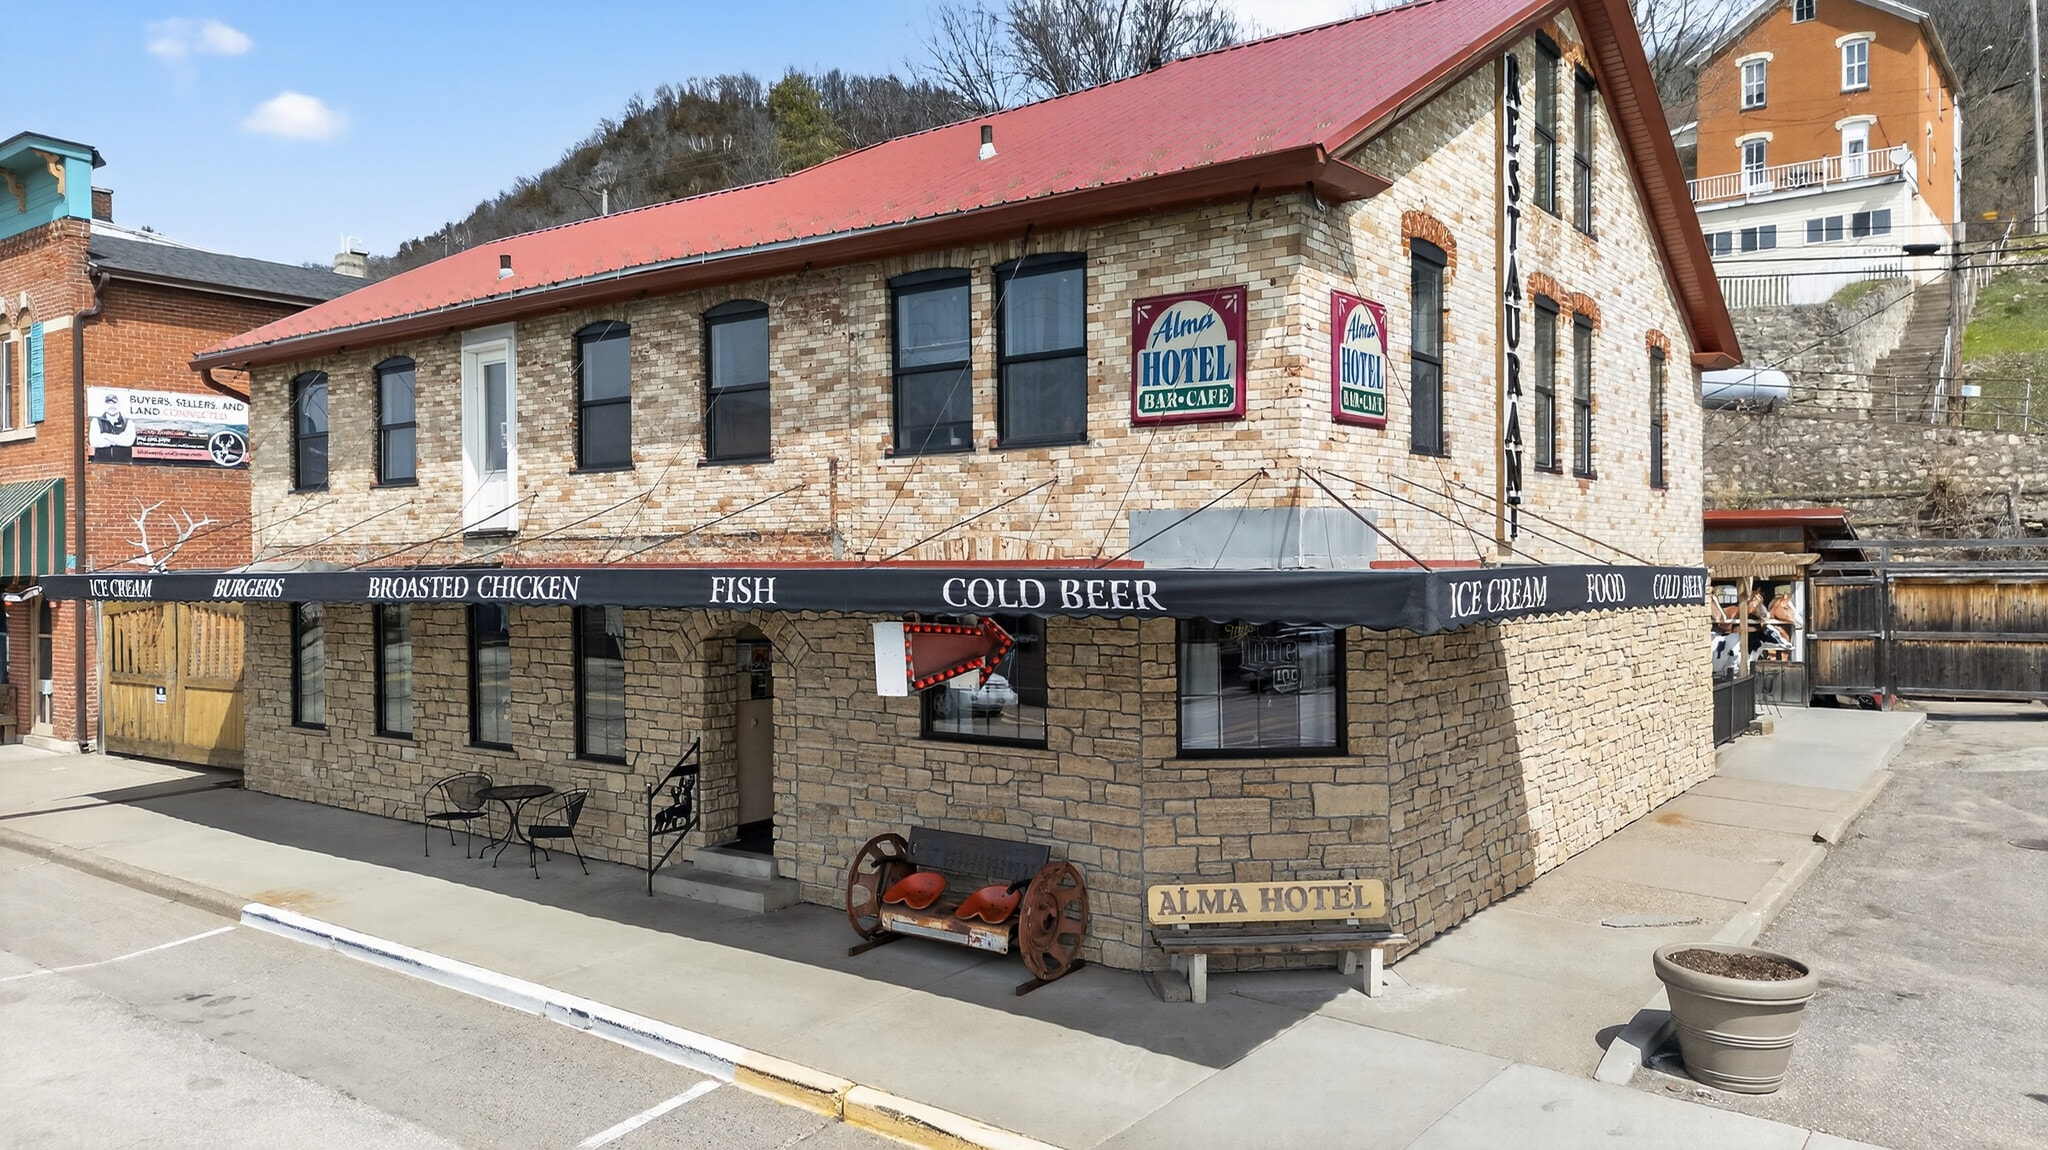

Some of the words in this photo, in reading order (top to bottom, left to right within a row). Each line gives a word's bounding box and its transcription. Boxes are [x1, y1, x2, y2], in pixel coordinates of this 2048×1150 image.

[1505, 53, 1522, 540] RESTAURANT
[1152, 310, 1215, 349] Alma
[1345, 312, 1376, 345] Alma
[1142, 344, 1231, 387] HOTEL
[1341, 346, 1384, 390] HOTEL
[129, 395, 172, 406] BUYERS,
[176, 398, 218, 410] SELLERS,
[222, 402, 245, 411] AND
[130, 406, 160, 415] LAND
[89, 579, 109, 597] ICE
[110, 578, 153, 598] CREAM
[212, 578, 285, 598] BURGERS
[366, 575, 469, 599] BROASTED
[477, 575, 581, 601] CHICKEN
[709, 576, 778, 604] FISH
[942, 577, 1046, 609] COLD
[1058, 579, 1167, 611] BEER
[1449, 580, 1483, 618] ICE
[1486, 575, 1548, 613] CREAM
[1585, 573, 1626, 603] FOOD
[1653, 573, 1681, 600] COLD
[1158, 889, 1248, 915] ALMA
[1258, 885, 1372, 912] HOTEL
